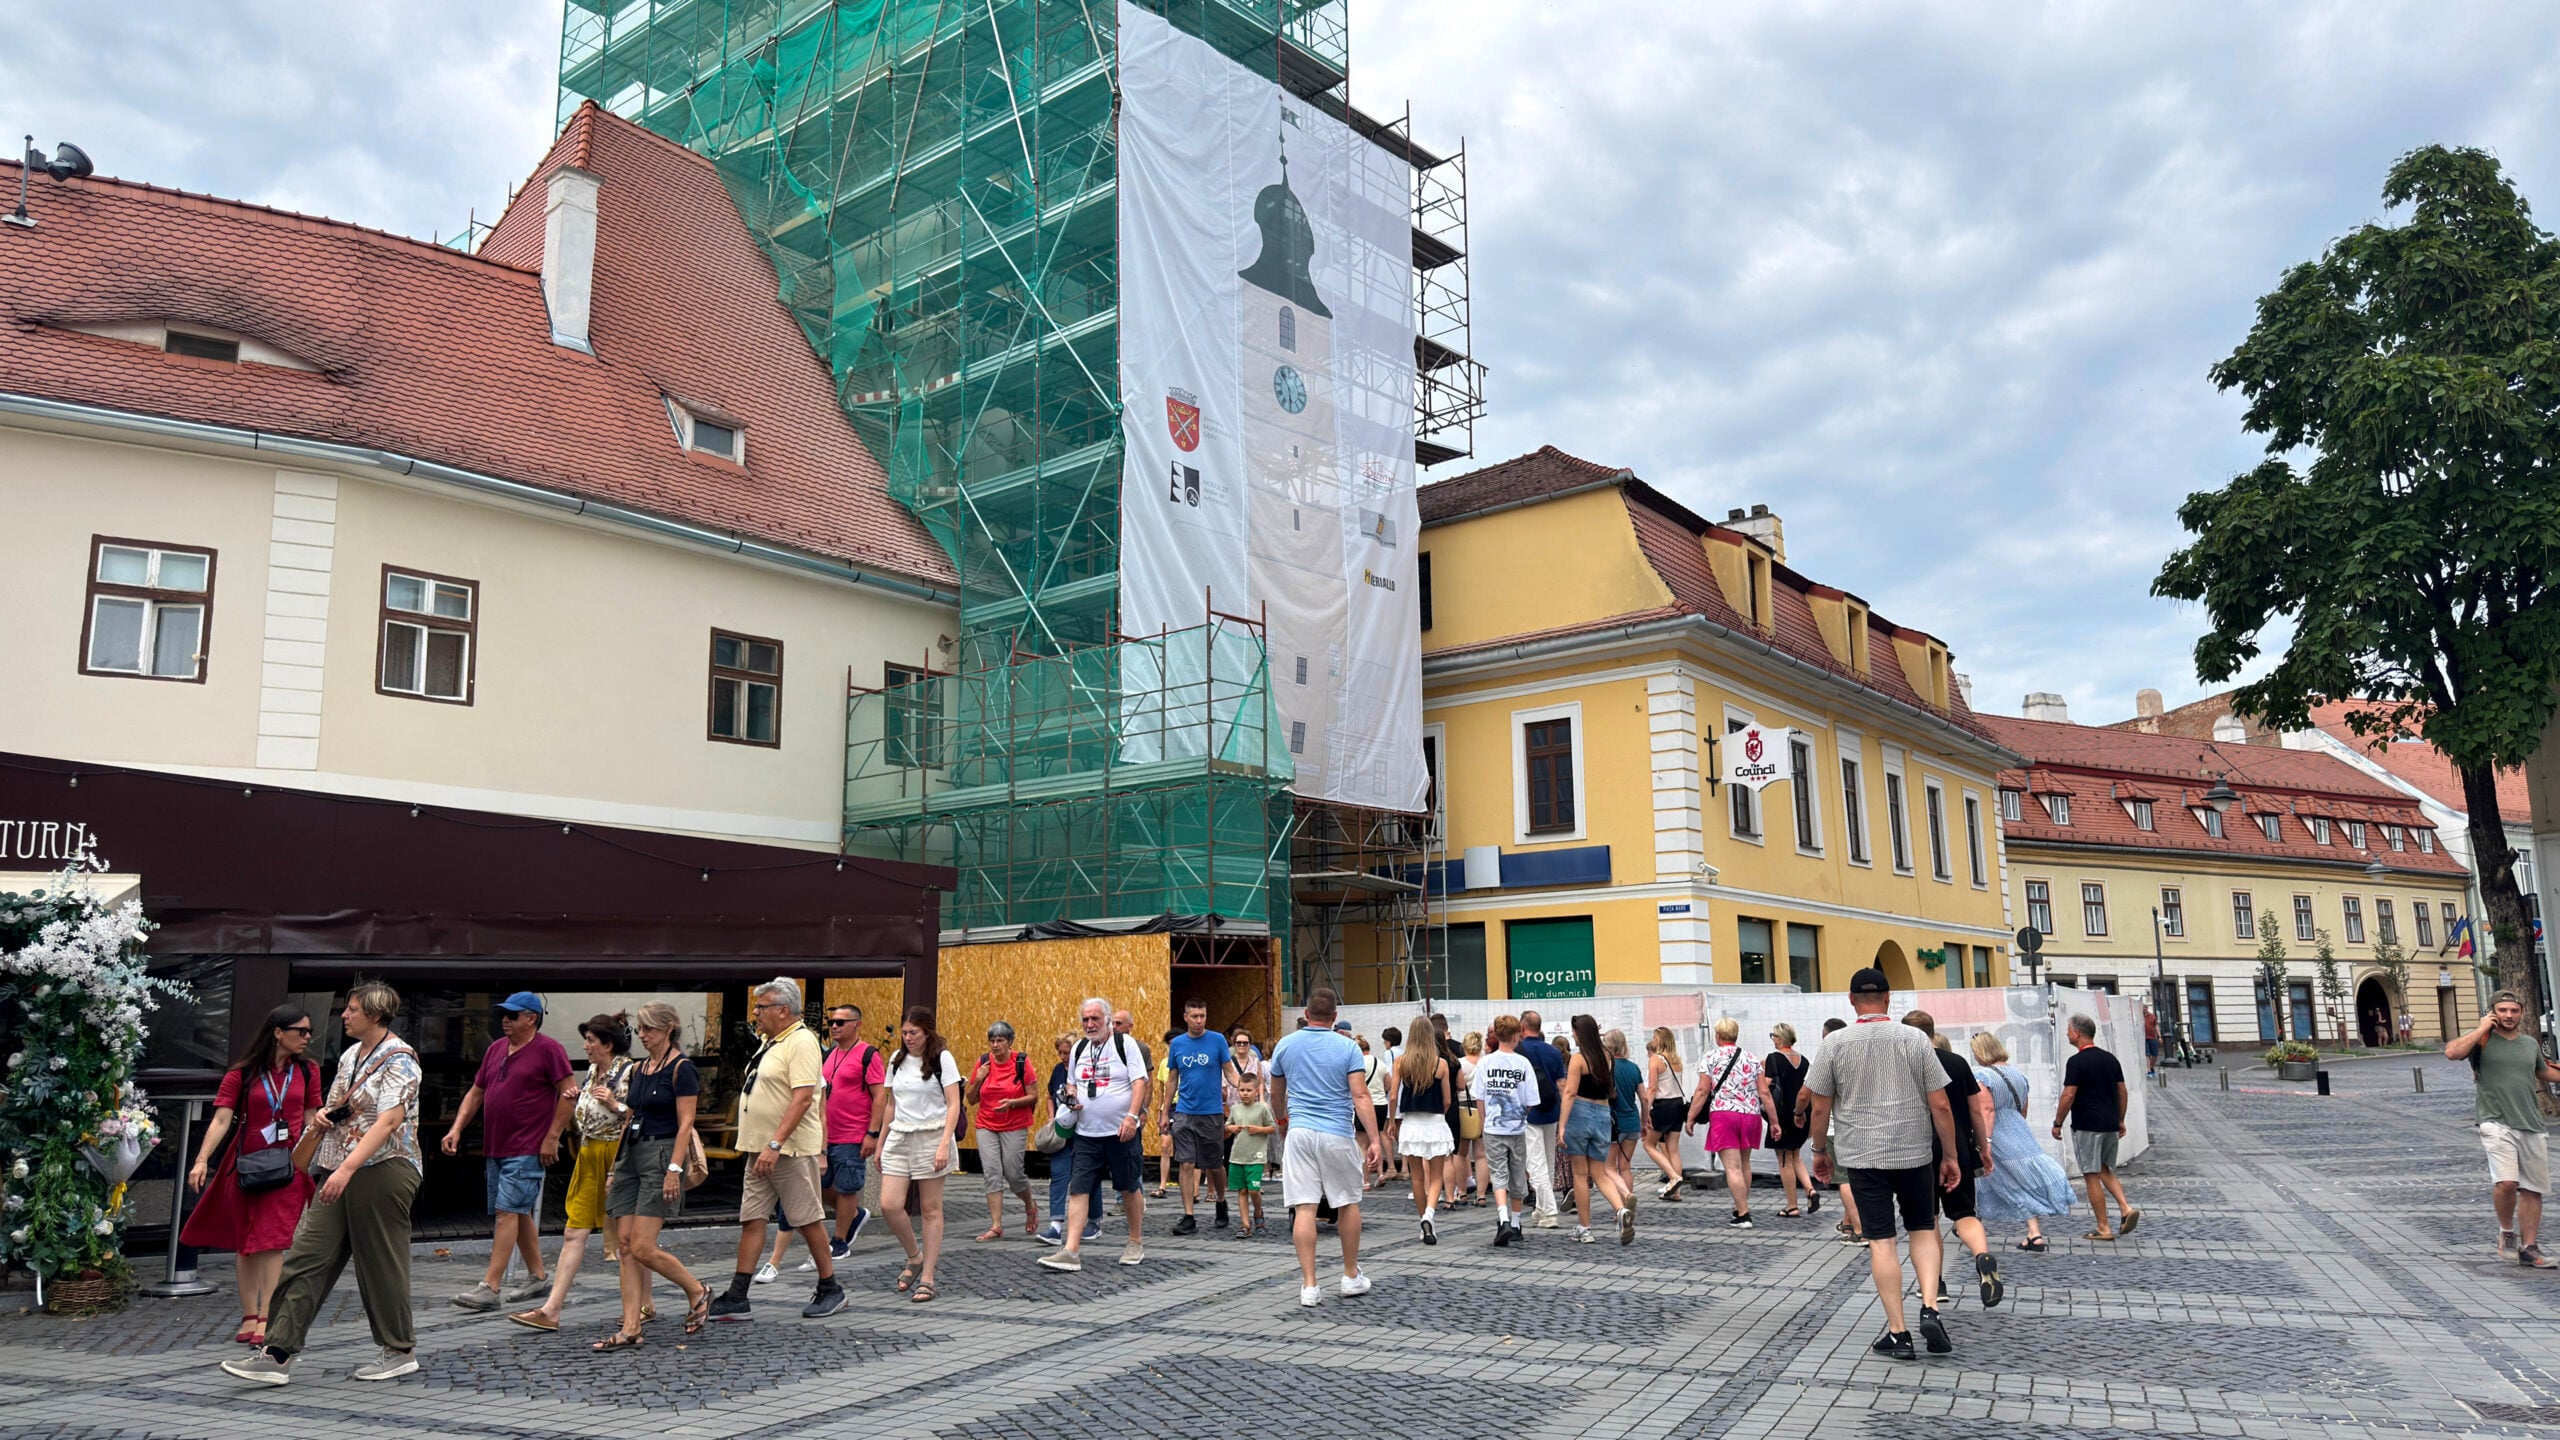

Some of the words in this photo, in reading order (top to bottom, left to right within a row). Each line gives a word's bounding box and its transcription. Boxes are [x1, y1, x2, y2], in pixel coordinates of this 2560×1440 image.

[1735, 763, 1776, 777] Council
[0, 820, 87, 860] TURN
[1515, 968, 1592, 986] Program
